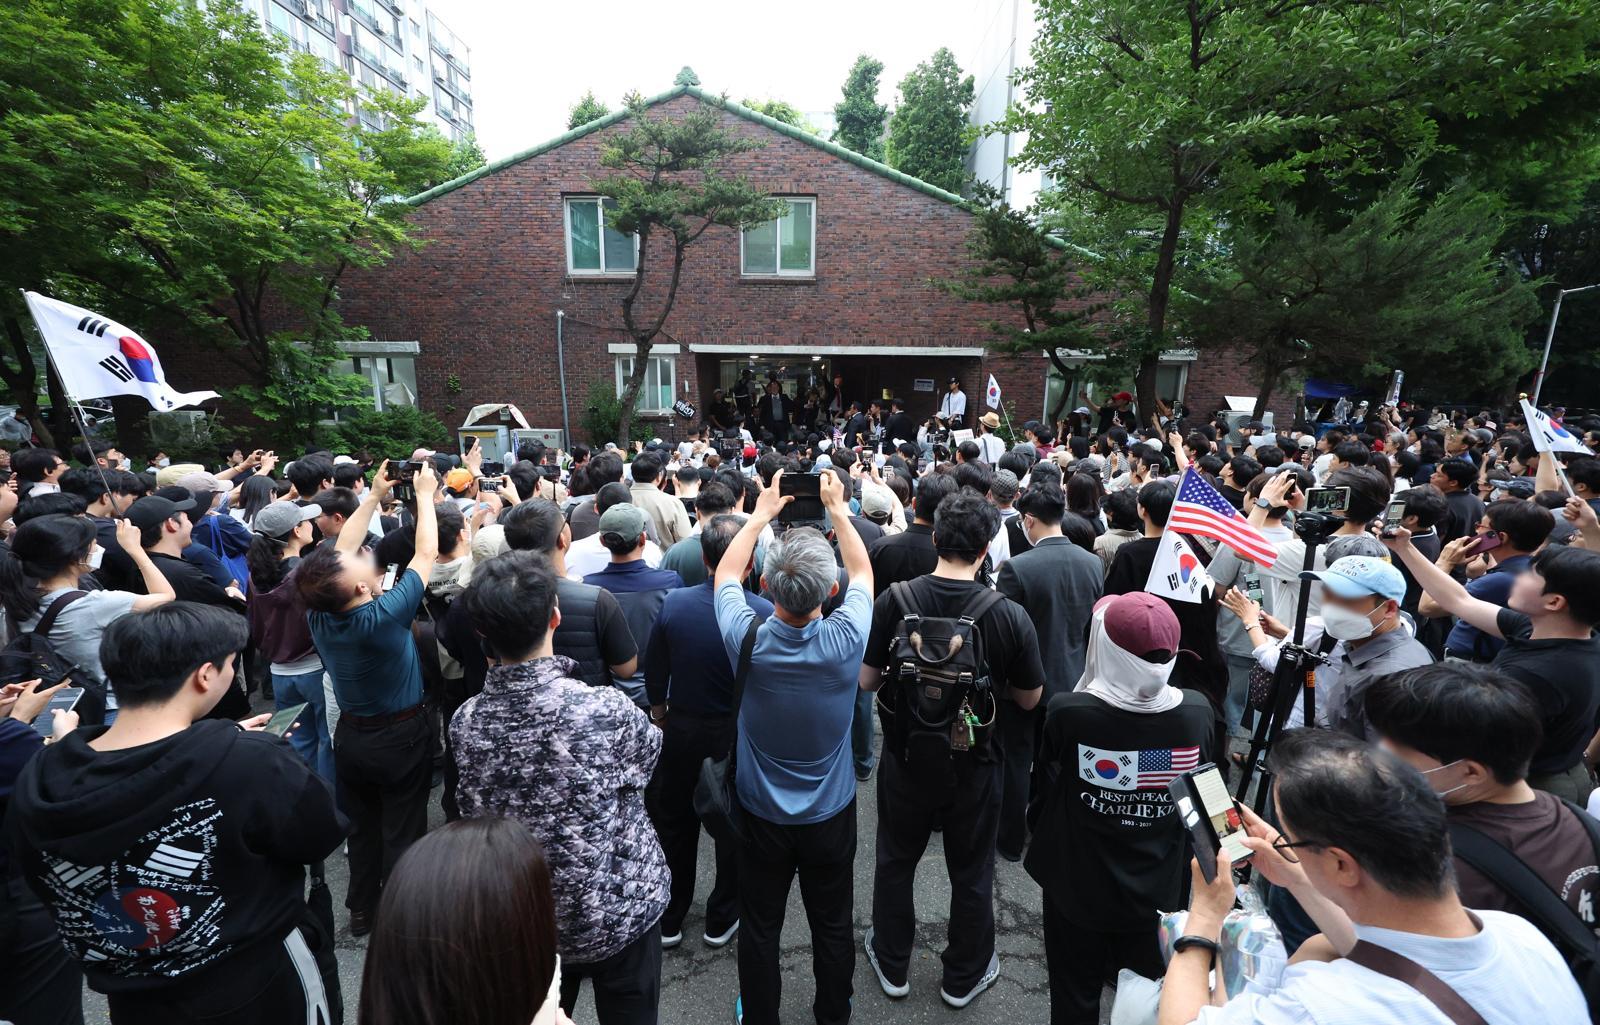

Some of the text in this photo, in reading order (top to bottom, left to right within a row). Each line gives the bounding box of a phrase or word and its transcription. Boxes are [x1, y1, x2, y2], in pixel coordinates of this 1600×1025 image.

[1080, 792, 1176, 818] CHARLIE KI
[1099, 790, 1173, 802] REST IN PEAC
